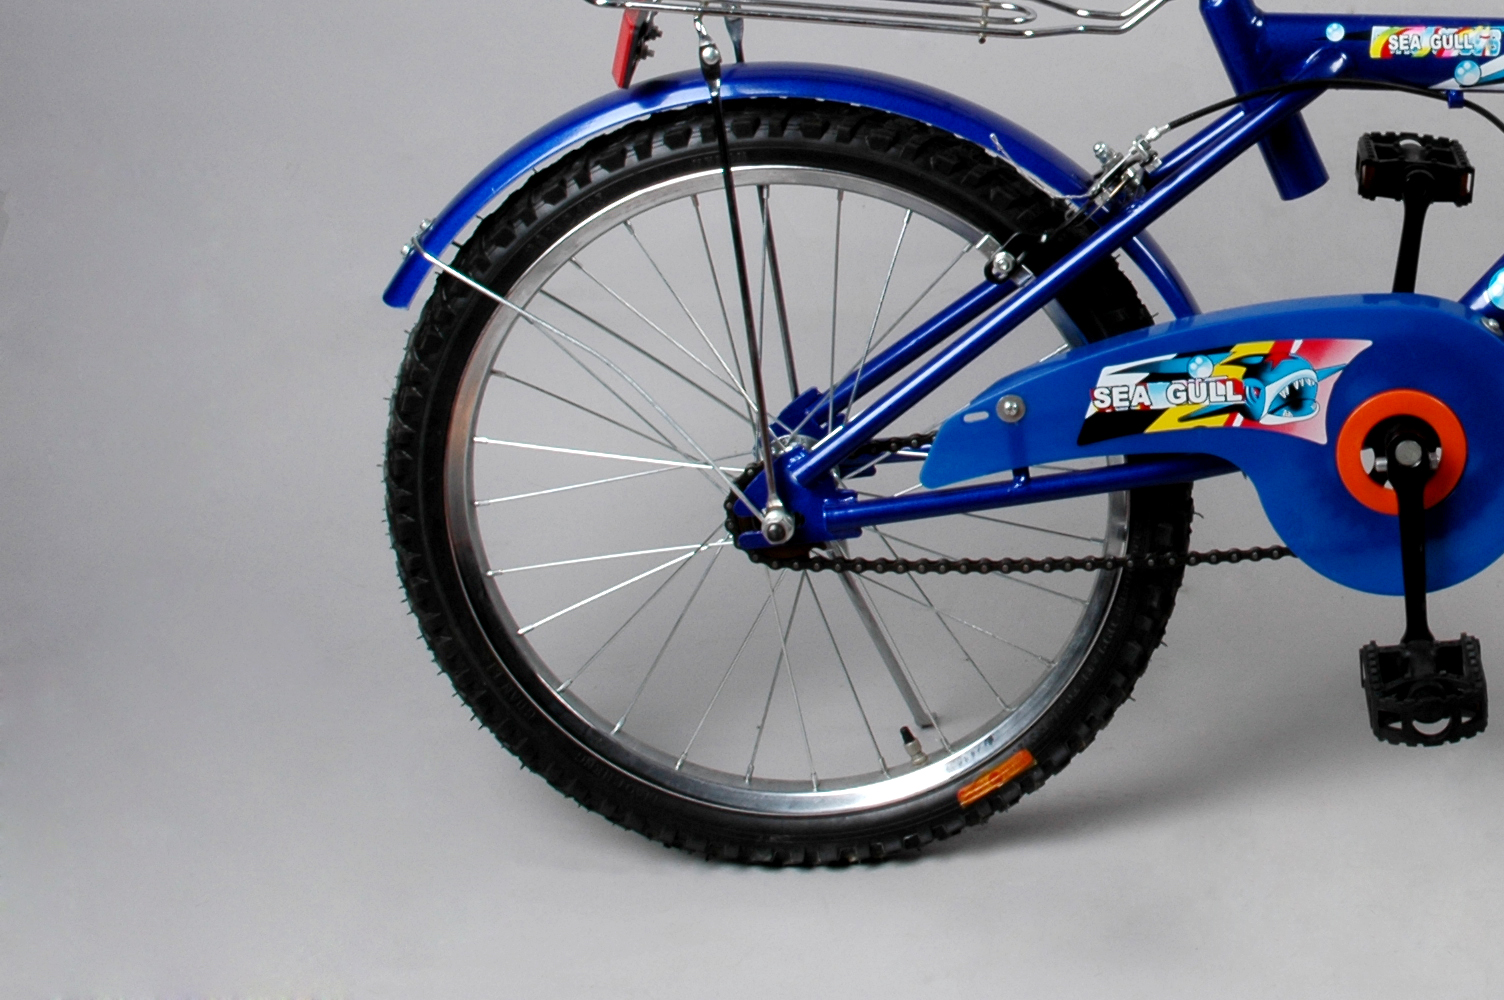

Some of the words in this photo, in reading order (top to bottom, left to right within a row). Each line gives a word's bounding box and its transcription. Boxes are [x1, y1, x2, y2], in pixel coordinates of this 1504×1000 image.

[1388, 33, 1421, 51] SEA
[1430, 33, 1475, 51] GULL
[1093, 384, 1152, 409] SEA
[1166, 380, 1243, 405] GULL
